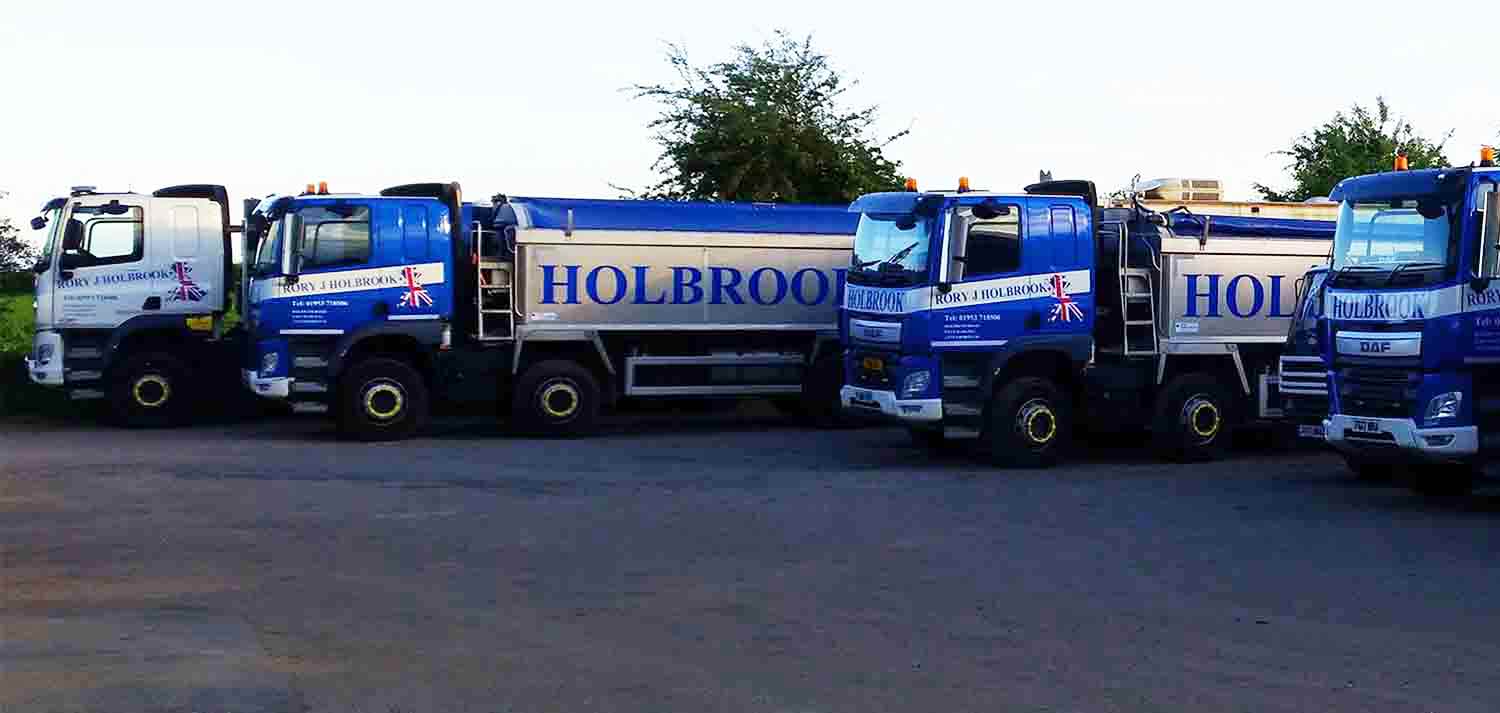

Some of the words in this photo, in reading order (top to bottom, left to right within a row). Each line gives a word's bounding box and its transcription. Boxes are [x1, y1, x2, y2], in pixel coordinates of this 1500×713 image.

[57, 278, 89, 289] RORY
[101, 271, 171, 286] HOLBROOK
[283, 279, 316, 294] RORY
[329, 275, 398, 290] HOLBROOK
[848, 286, 904, 313] HOLBROOK
[935, 290, 969, 305] RORY
[981, 283, 1047, 300] HOLBROOK
[1181, 273, 1294, 318] HOL
[1333, 294, 1425, 319] HOLBROOK
